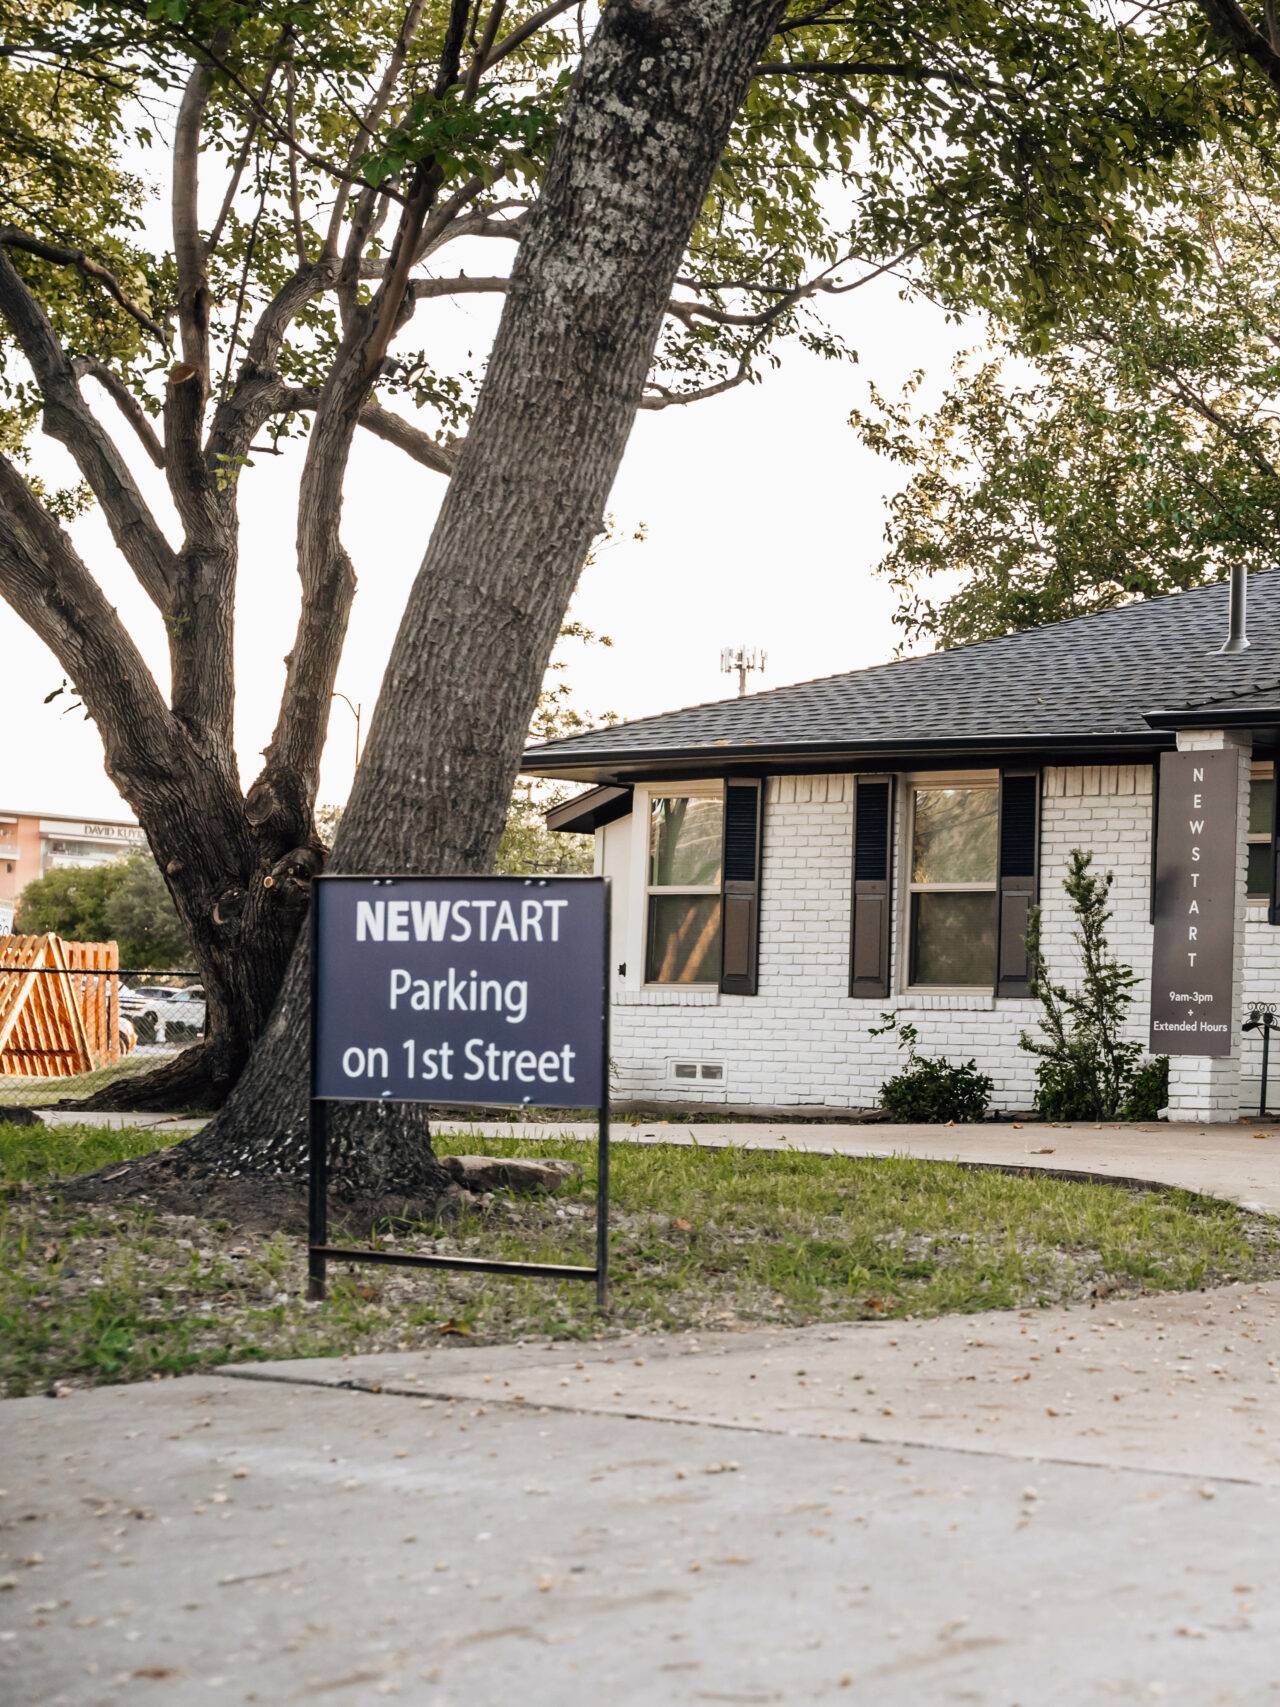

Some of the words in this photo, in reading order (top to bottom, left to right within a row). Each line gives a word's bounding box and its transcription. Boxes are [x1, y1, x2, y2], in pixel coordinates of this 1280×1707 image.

[84, 825, 115, 836] DAVID
[1187, 767, 1204, 968] NEWSTART
[356, 900, 568, 942] NEWSTART
[390, 967, 528, 1024] Parking
[1169, 991, 1213, 1004] 9am-3pm
[1153, 1020, 1197, 1031] Extended
[1200, 1021, 1228, 1032] Hours
[342, 1047, 389, 1078] on
[403, 1039, 454, 1080] 1st
[463, 1038, 576, 1083] Street
